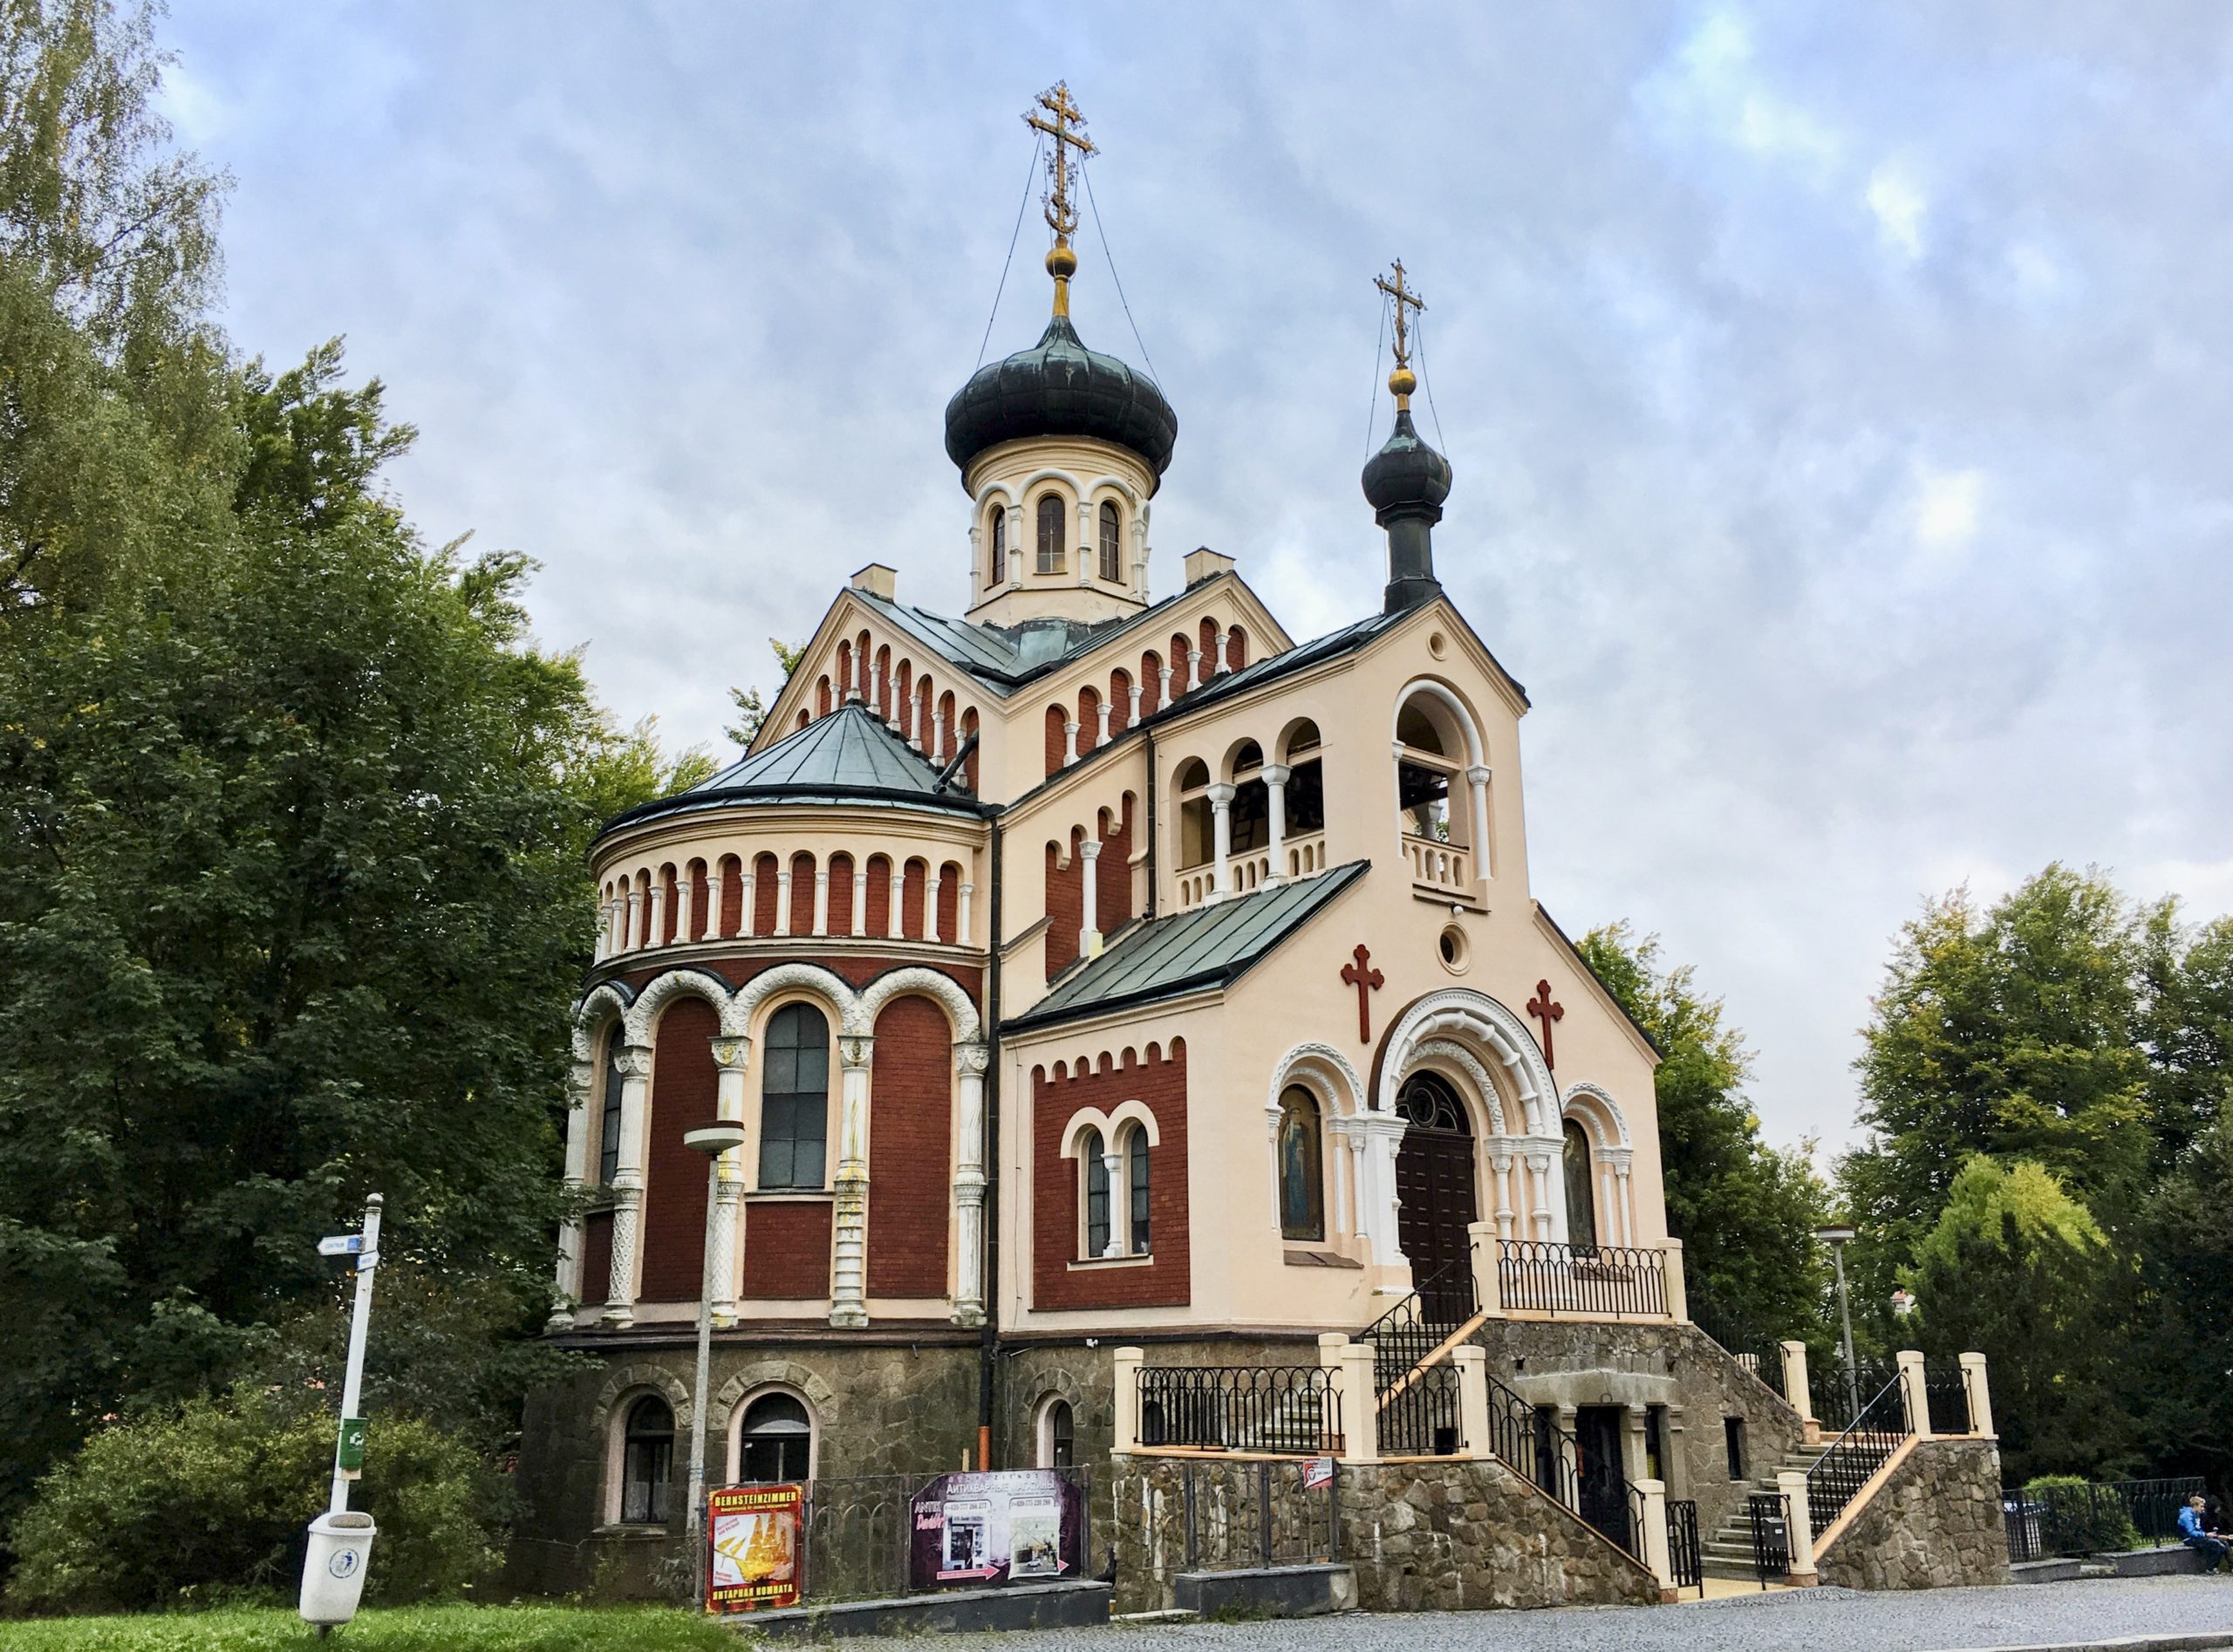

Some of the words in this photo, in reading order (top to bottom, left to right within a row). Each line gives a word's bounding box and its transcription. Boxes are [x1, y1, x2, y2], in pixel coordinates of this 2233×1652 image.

[715, 1492, 796, 1507] BERNSTEINZIMMER
[713, 1587, 754, 1601] ЯНТАРНАЯ
[755, 1584, 793, 1596] КОМНАТА
